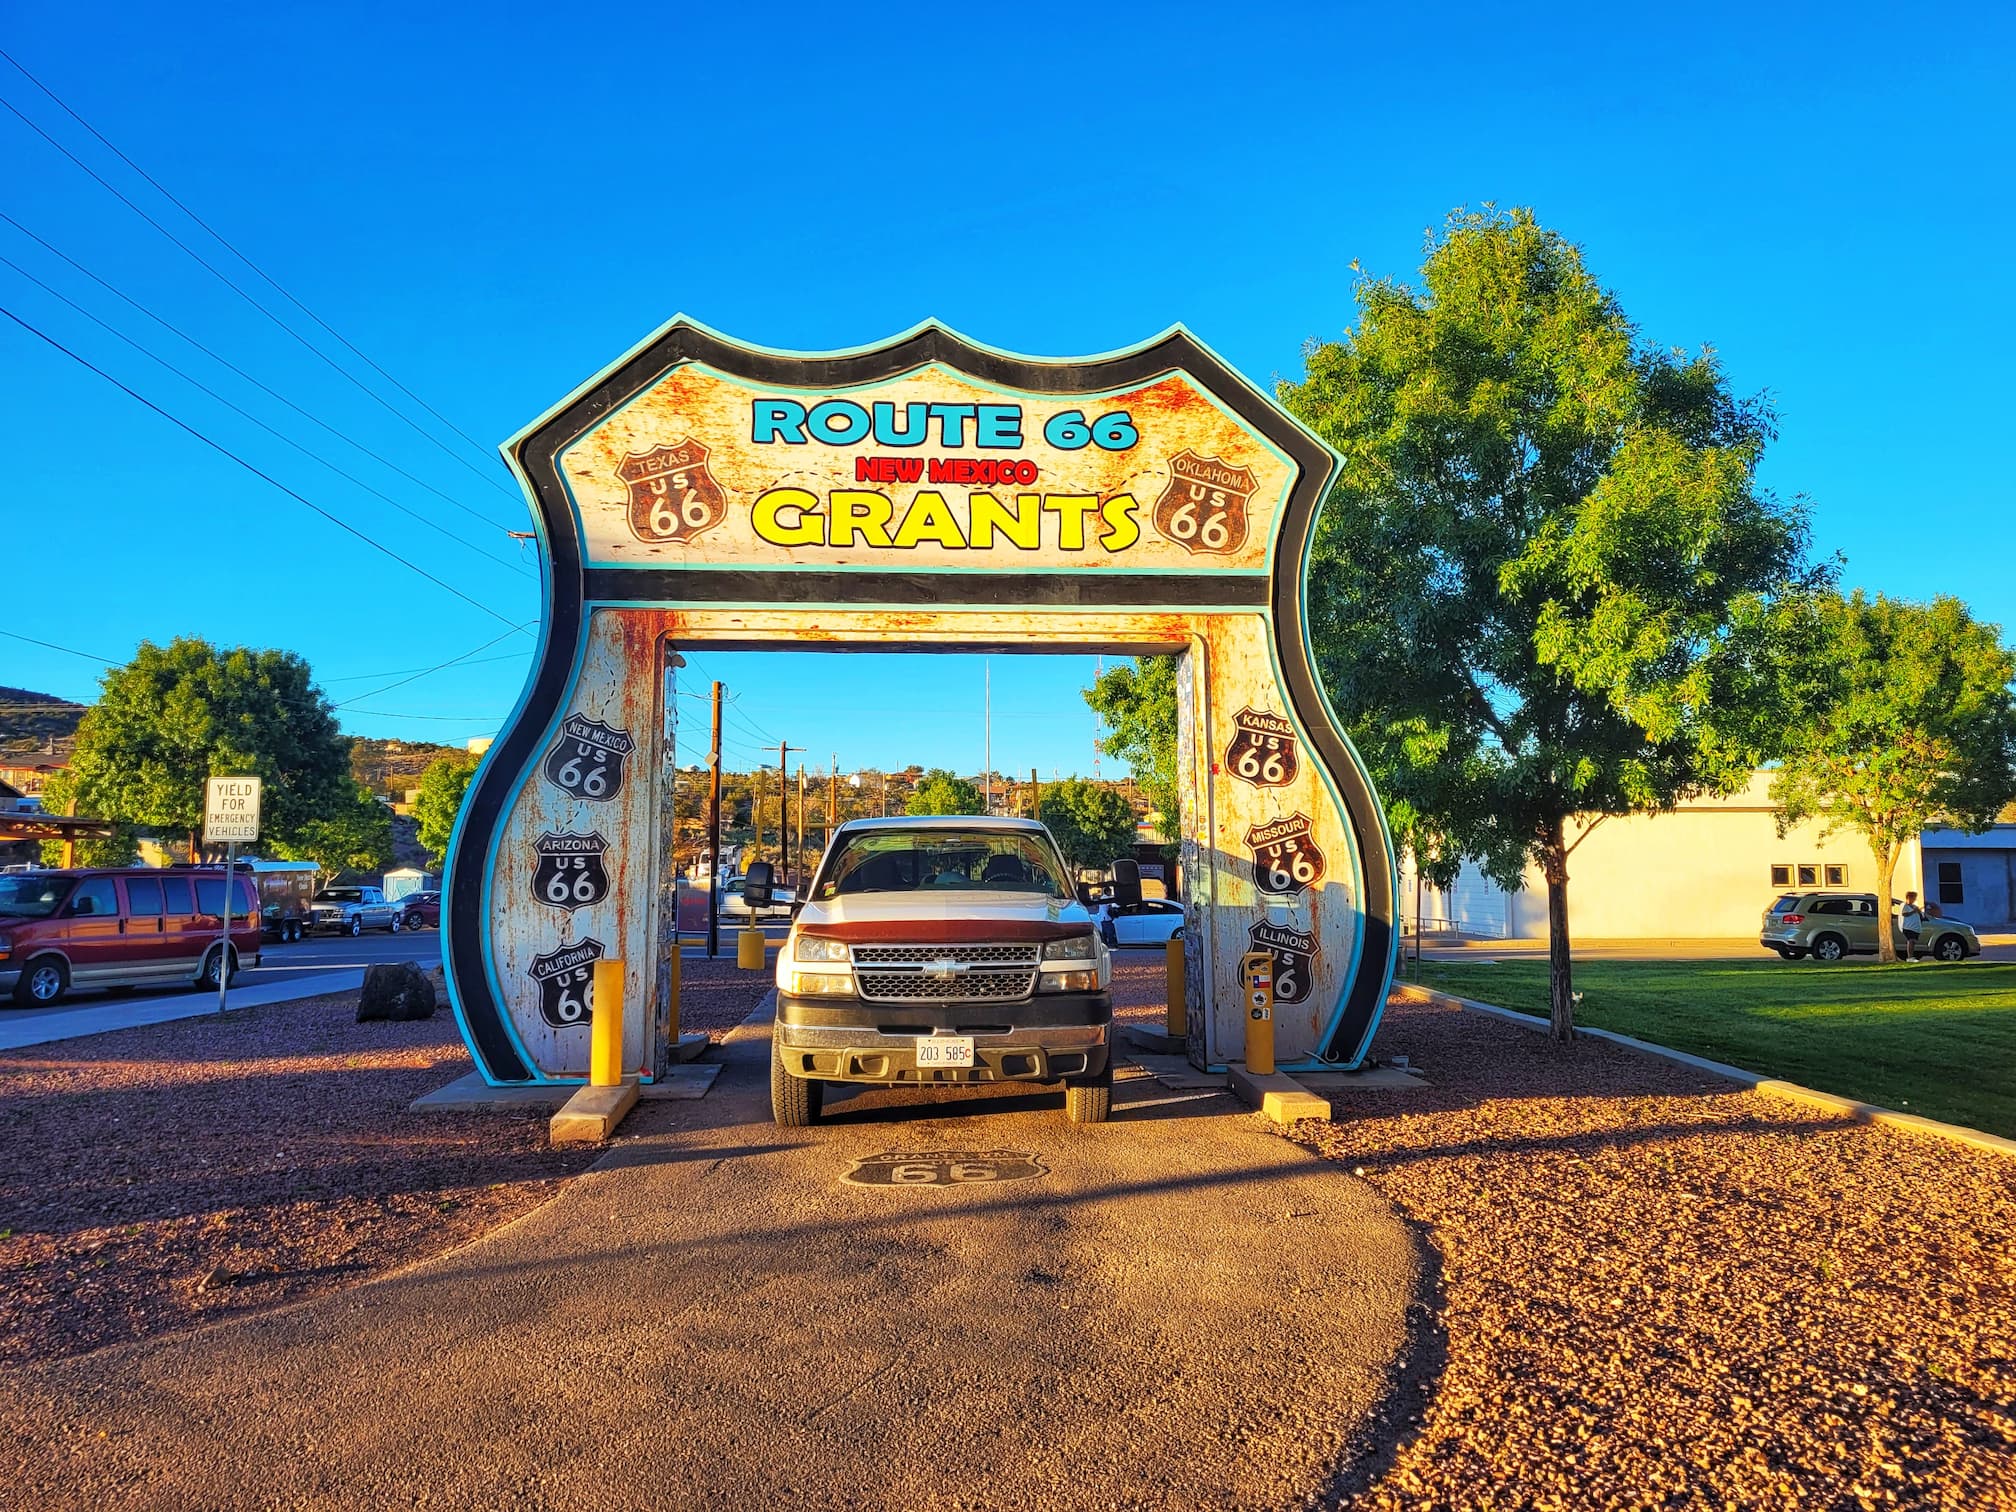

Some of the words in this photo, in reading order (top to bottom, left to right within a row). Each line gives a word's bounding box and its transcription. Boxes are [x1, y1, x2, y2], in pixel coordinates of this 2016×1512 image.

[752, 400, 1024, 449] ROUTE
[1043, 410, 1140, 451] 66
[635, 450, 690, 474] TEXAS
[855, 456, 926, 483] NEW
[928, 458, 1039, 486] MEXICO
[1176, 459, 1250, 491] OKLAHOMA
[649, 488, 712, 537] 66
[750, 487, 1141, 553] GRANTS
[1170, 502, 1229, 548] 66
[569, 722, 591, 738] NEW
[592, 730, 627, 751] MEXICO
[1243, 714, 1294, 734] KANSAS
[558, 757, 607, 797] 66
[1238, 747, 1285, 783] 66
[217, 784, 252, 796] YIELD
[222, 798, 245, 810] FOR
[208, 826, 256, 837] VEHICLES
[209, 813, 256, 823] EMERGENCY
[1251, 819, 1305, 844] MISSOURI
[542, 840, 600, 851] ARIZONA
[1269, 852, 1315, 890] 66
[546, 871, 596, 902] 66
[1259, 928, 1310, 949] ILLINOIS
[537, 947, 596, 976] CALIFORNIA
[920, 1046, 939, 1061] 203
[891, 1162, 998, 1183] 66
